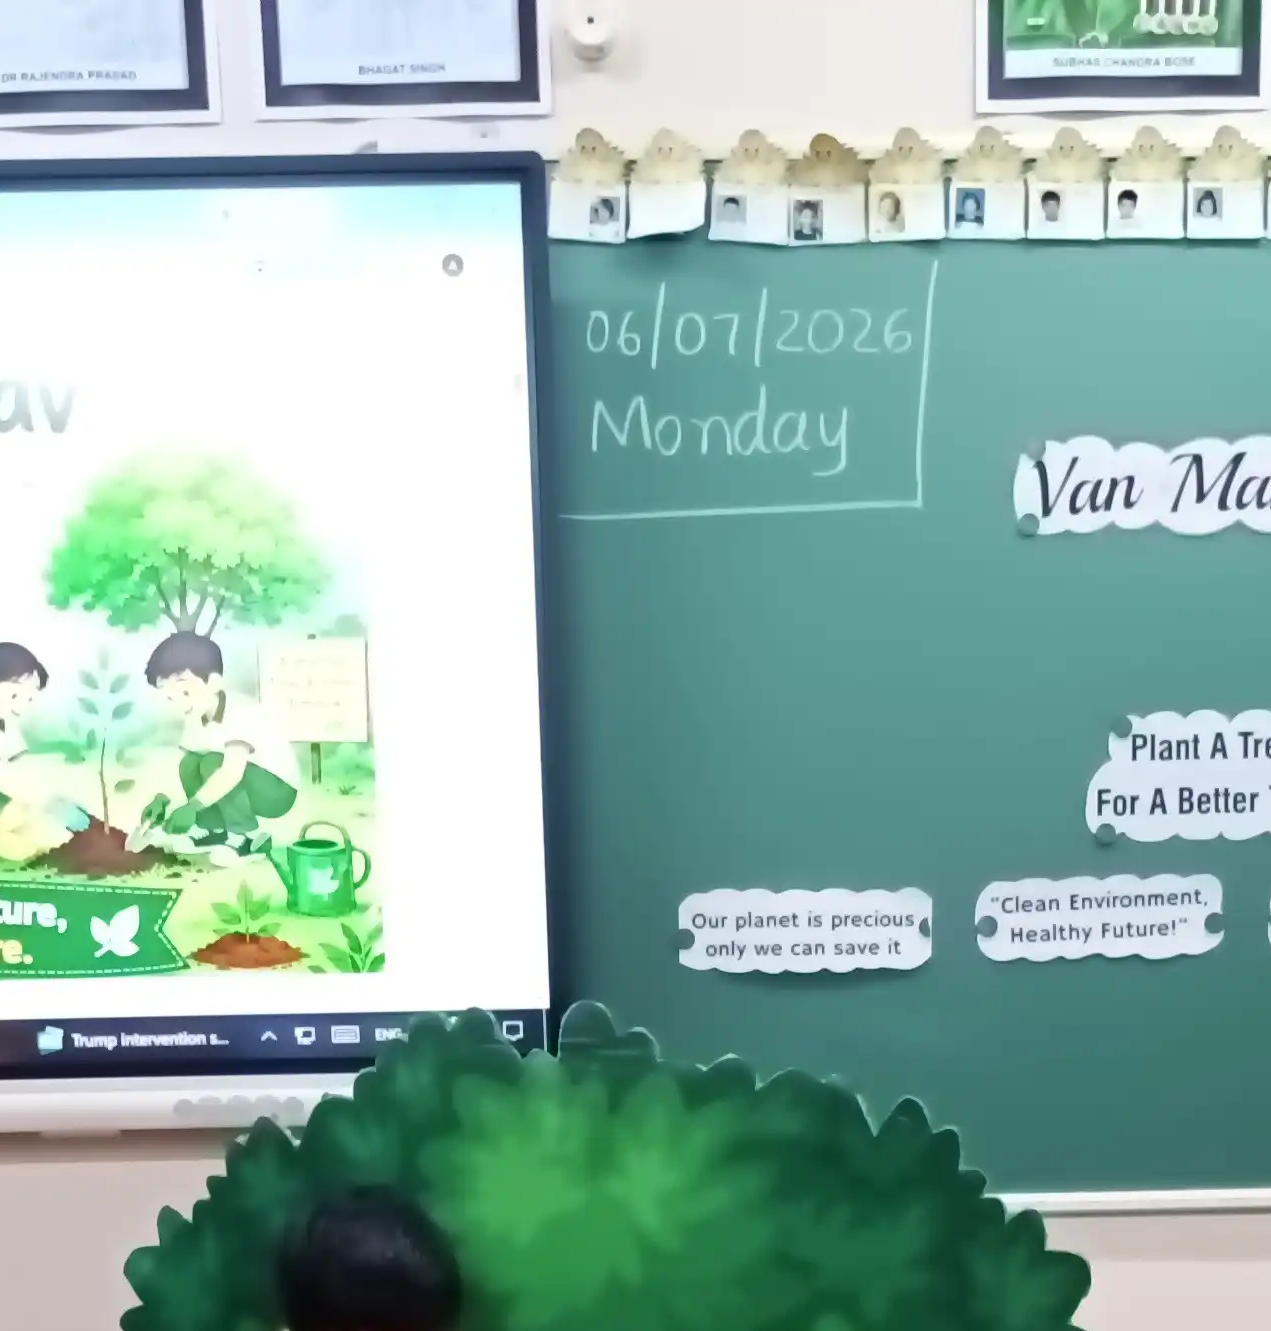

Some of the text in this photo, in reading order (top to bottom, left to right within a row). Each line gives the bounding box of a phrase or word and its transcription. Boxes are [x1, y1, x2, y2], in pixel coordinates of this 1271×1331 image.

[357, 63, 447, 75] BHAGAT SINGH
[1052, 56, 1196, 68] SUBHAS CHANDRA BOSE
[20, 71, 85, 82] RAJENDRA
[87, 70, 138, 82] PRASAD
[586, 282, 914, 370] 06/07/2026
[591, 382, 848, 477] Monday
[1032, 456, 1143, 518] Van
[1131, 733, 1201, 762] Plant
[1210, 732, 1229, 760] A
[1096, 788, 1140, 817] For
[1148, 788, 1169, 816] A
[1177, 786, 1260, 816] Better
[1069, 888, 1210, 912] Environment,
[691, 910, 915, 935] Our planet is precious
[1010, 922, 1093, 945] Healthy
[704, 937, 902, 962] only we can save it
[71, 1032, 118, 1051] Trump
